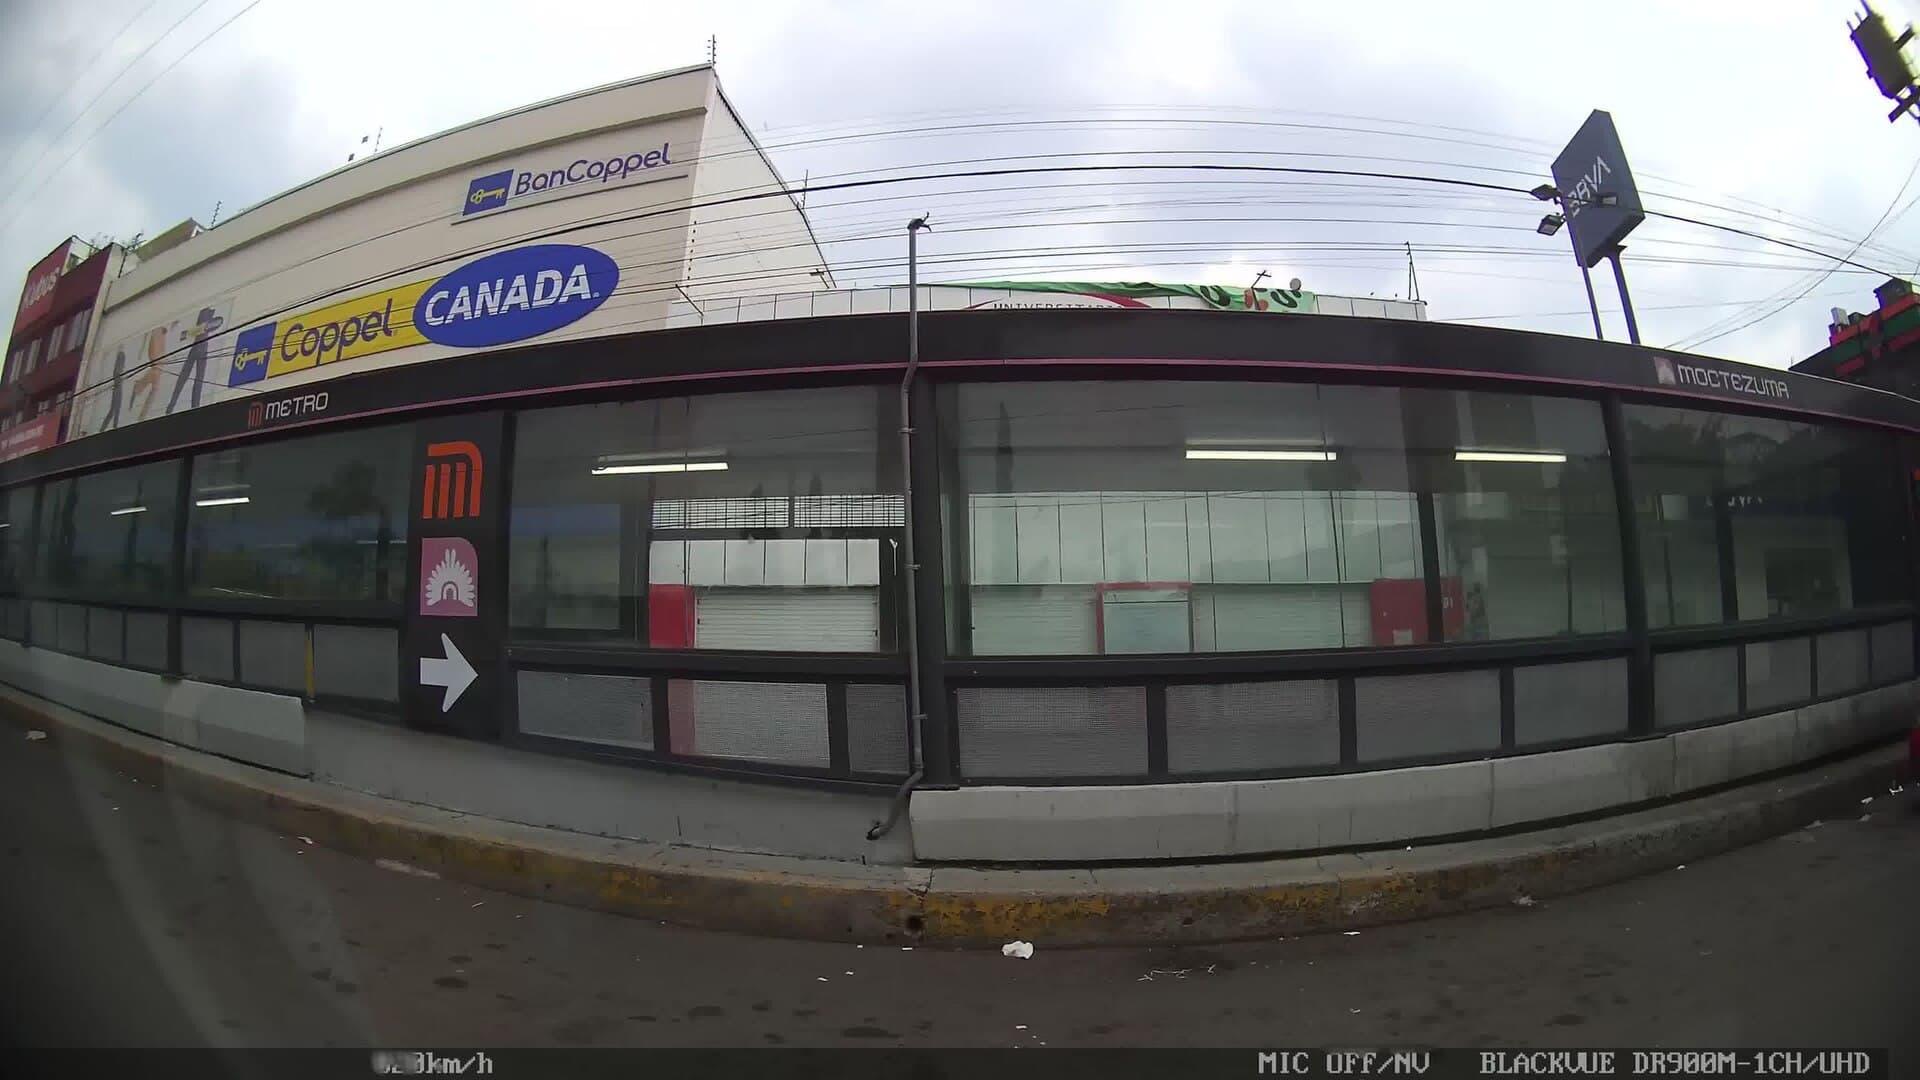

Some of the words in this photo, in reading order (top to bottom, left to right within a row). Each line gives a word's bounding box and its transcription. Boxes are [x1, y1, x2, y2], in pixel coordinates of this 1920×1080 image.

[514, 142, 671, 195] BanCoppel
[281, 298, 396, 366] Coppel
[1677, 363, 1790, 399] MOCTEZUMA
[265, 392, 329, 420] METRO
